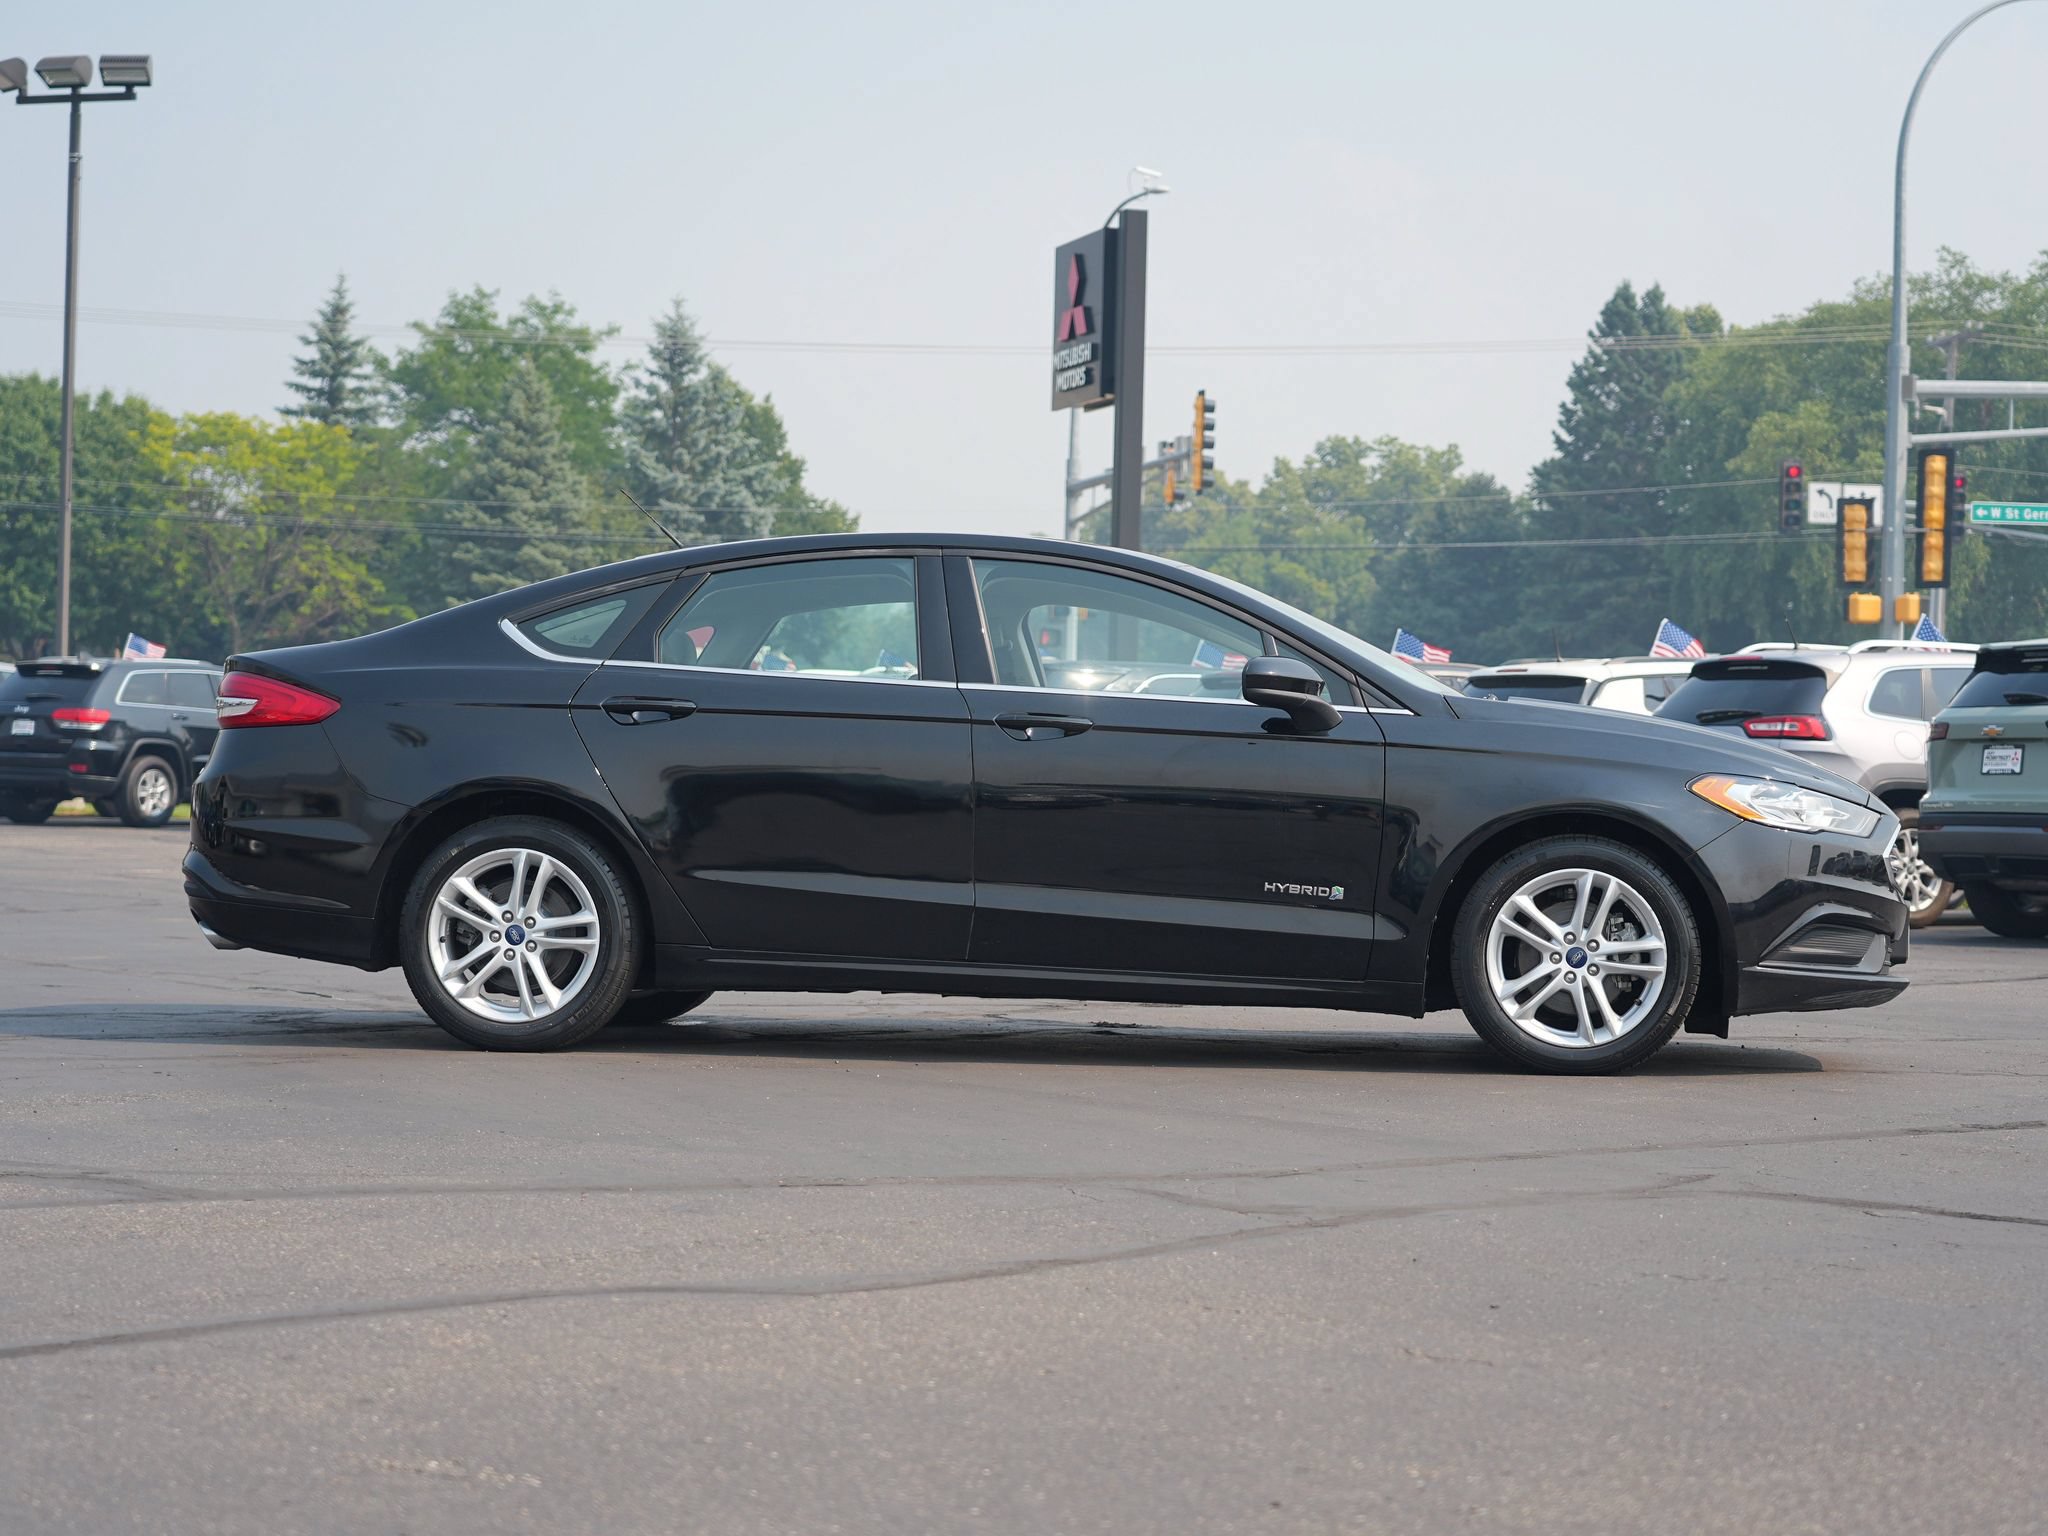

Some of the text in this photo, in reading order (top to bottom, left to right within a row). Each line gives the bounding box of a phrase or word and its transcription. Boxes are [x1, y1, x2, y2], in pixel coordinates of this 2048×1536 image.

[1055, 365, 1086, 391] MOTORS
[1990, 507, 2001, 518] W
[2006, 507, 2019, 519] St
[1264, 882, 1330, 897] HYBRID
